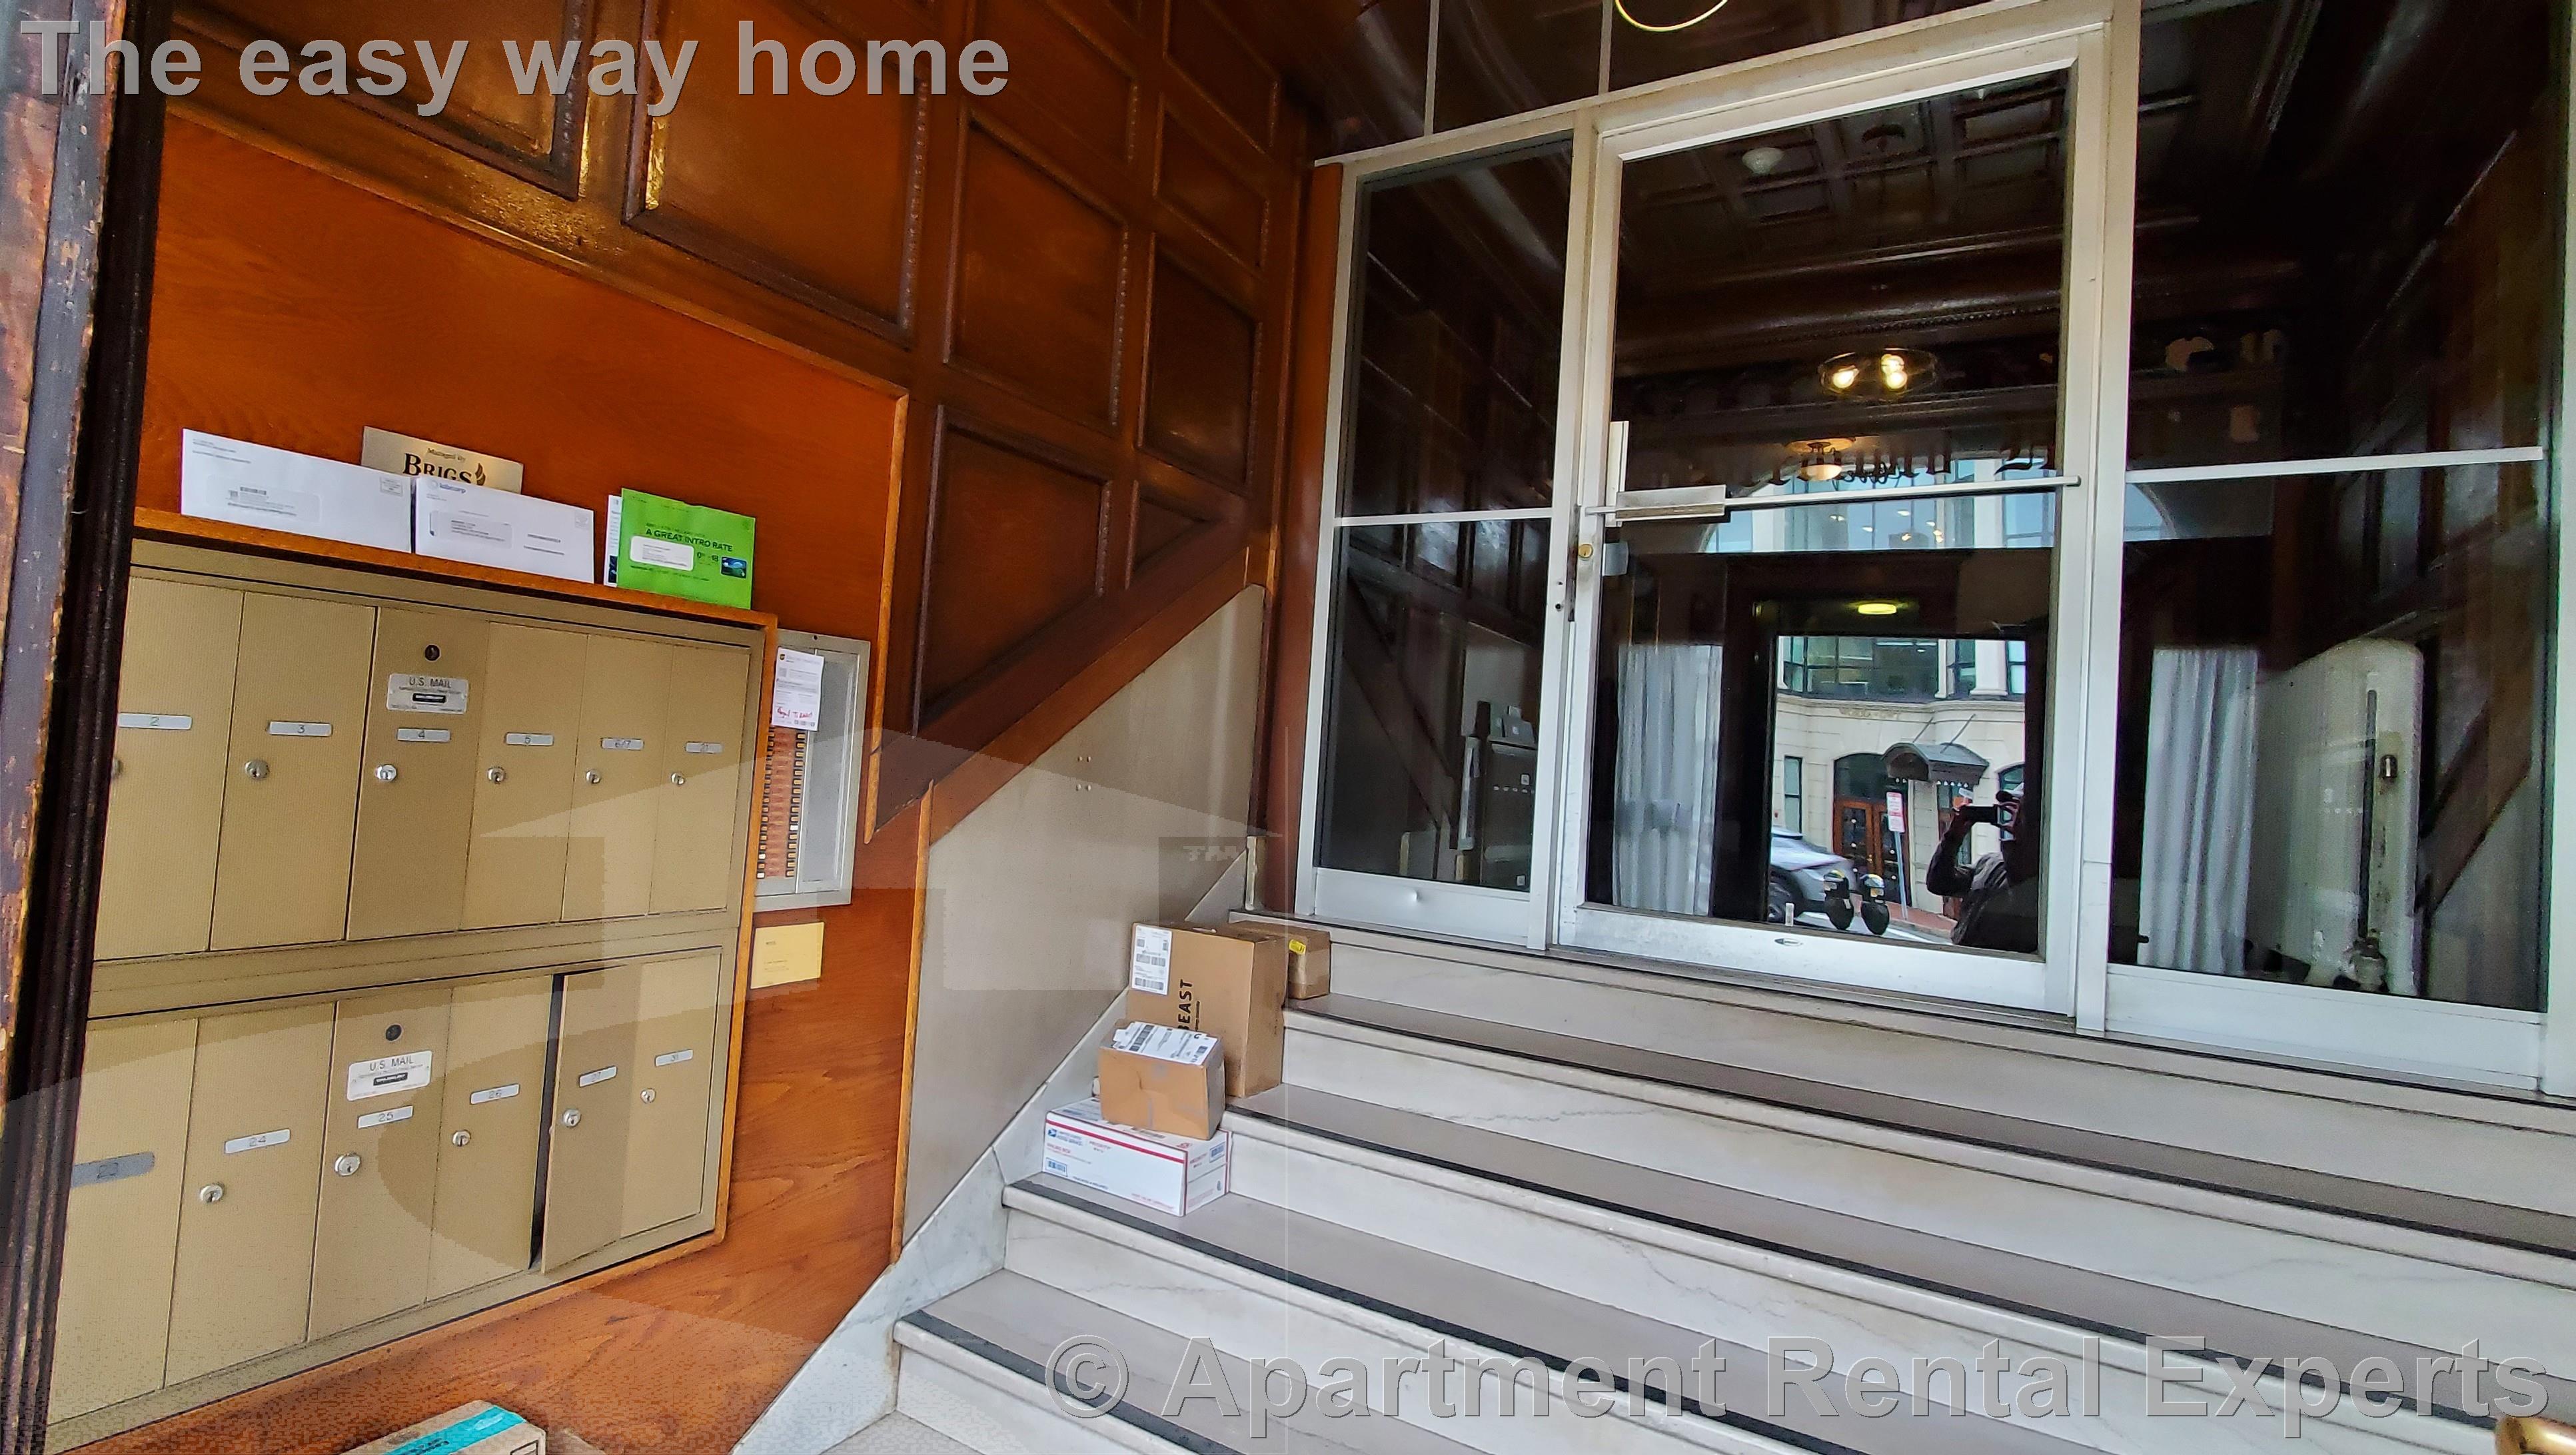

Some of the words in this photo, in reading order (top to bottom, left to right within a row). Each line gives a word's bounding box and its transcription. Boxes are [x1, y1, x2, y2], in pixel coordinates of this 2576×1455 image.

[402, 452, 472, 484] BRIGS
[645, 528, 652, 536] A
[654, 530, 683, 542] GREAT
[684, 536, 712, 548] INTRO
[712, 540, 734, 552] RATE
[430, 678, 452, 689] MAIL
[149, 716, 160, 727] 2
[297, 724, 306, 734] 3
[417, 730, 426, 739] 4
[391, 1055, 415, 1067] MAIL
[378, 1111, 394, 1123] 25
[249, 1135, 267, 1147] 24
